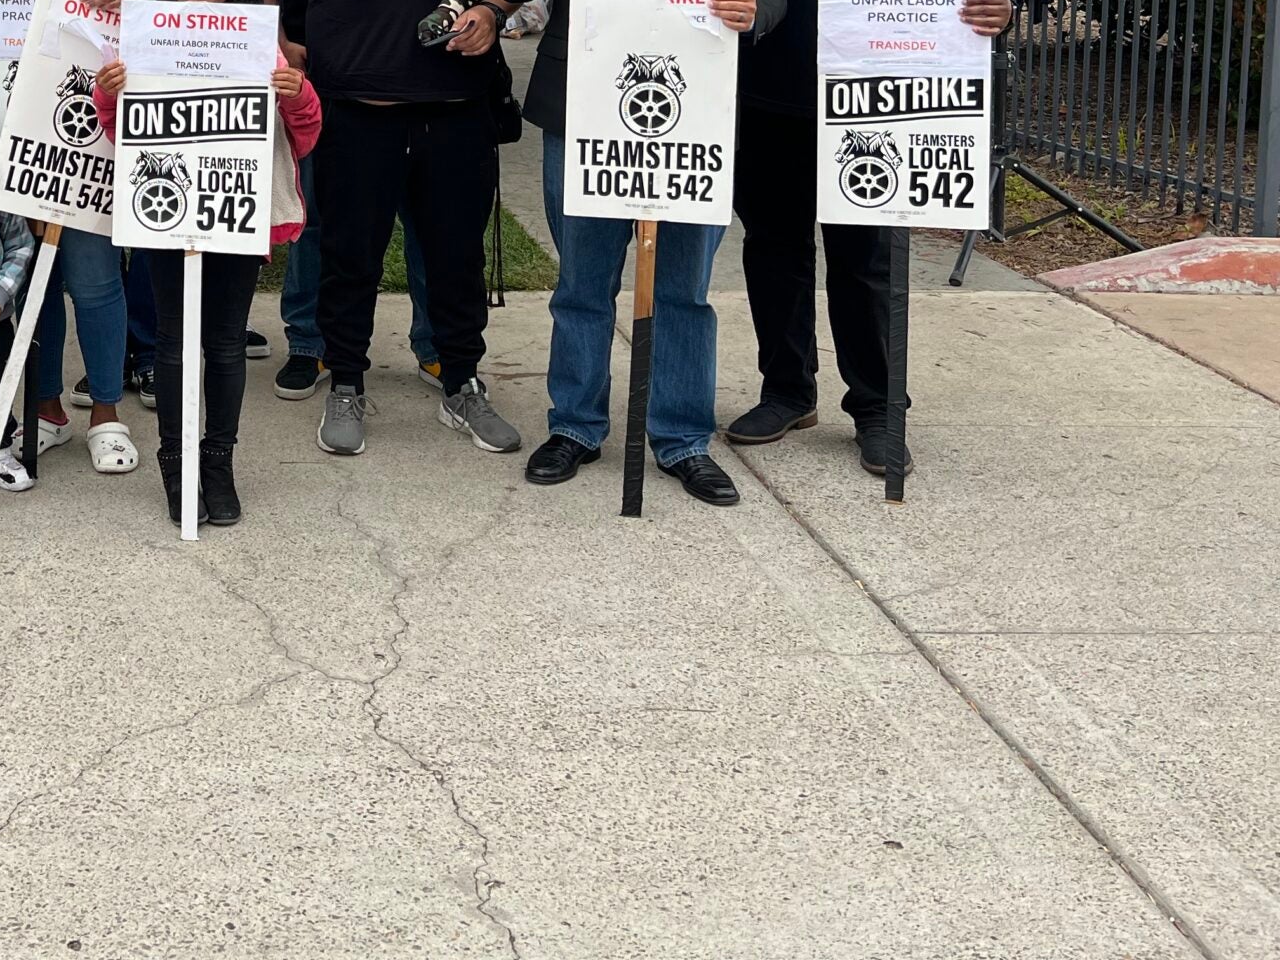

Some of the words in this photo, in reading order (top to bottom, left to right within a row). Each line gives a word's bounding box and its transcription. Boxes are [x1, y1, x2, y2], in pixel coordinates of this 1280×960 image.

[65, 0, 90, 18] ON
[868, 12, 938, 23] PRACTICE
[153, 13, 181, 28] ON
[187, 14, 248, 32] STRIKE
[150, 38, 180, 47] UNFAIR
[182, 40, 209, 48] LABOR
[210, 41, 248, 50] PRACTICE
[868, 40, 937, 51] TRANSDEV
[175, 61, 222, 71] TRANSDEV
[832, 82, 869, 115] ON
[877, 77, 977, 113] STRIKE
[128, 102, 163, 136] ON
[170, 97, 261, 134] STRIKE
[908, 134, 975, 147] TEAMSTERS
[8, 135, 114, 186] TEAMSTER
[198, 156, 258, 172] TEAMSTERS
[576, 138, 723, 172] TEAMSTERS
[908, 147, 975, 171] LOCAL
[4, 165, 71, 206] LOCAL
[76, 184, 114, 216] 542
[197, 170, 257, 195] LOCAL
[583, 168, 660, 199] LOCAL
[666, 174, 713, 202] 542
[908, 171, 975, 209] 542
[196, 194, 256, 234] 542
